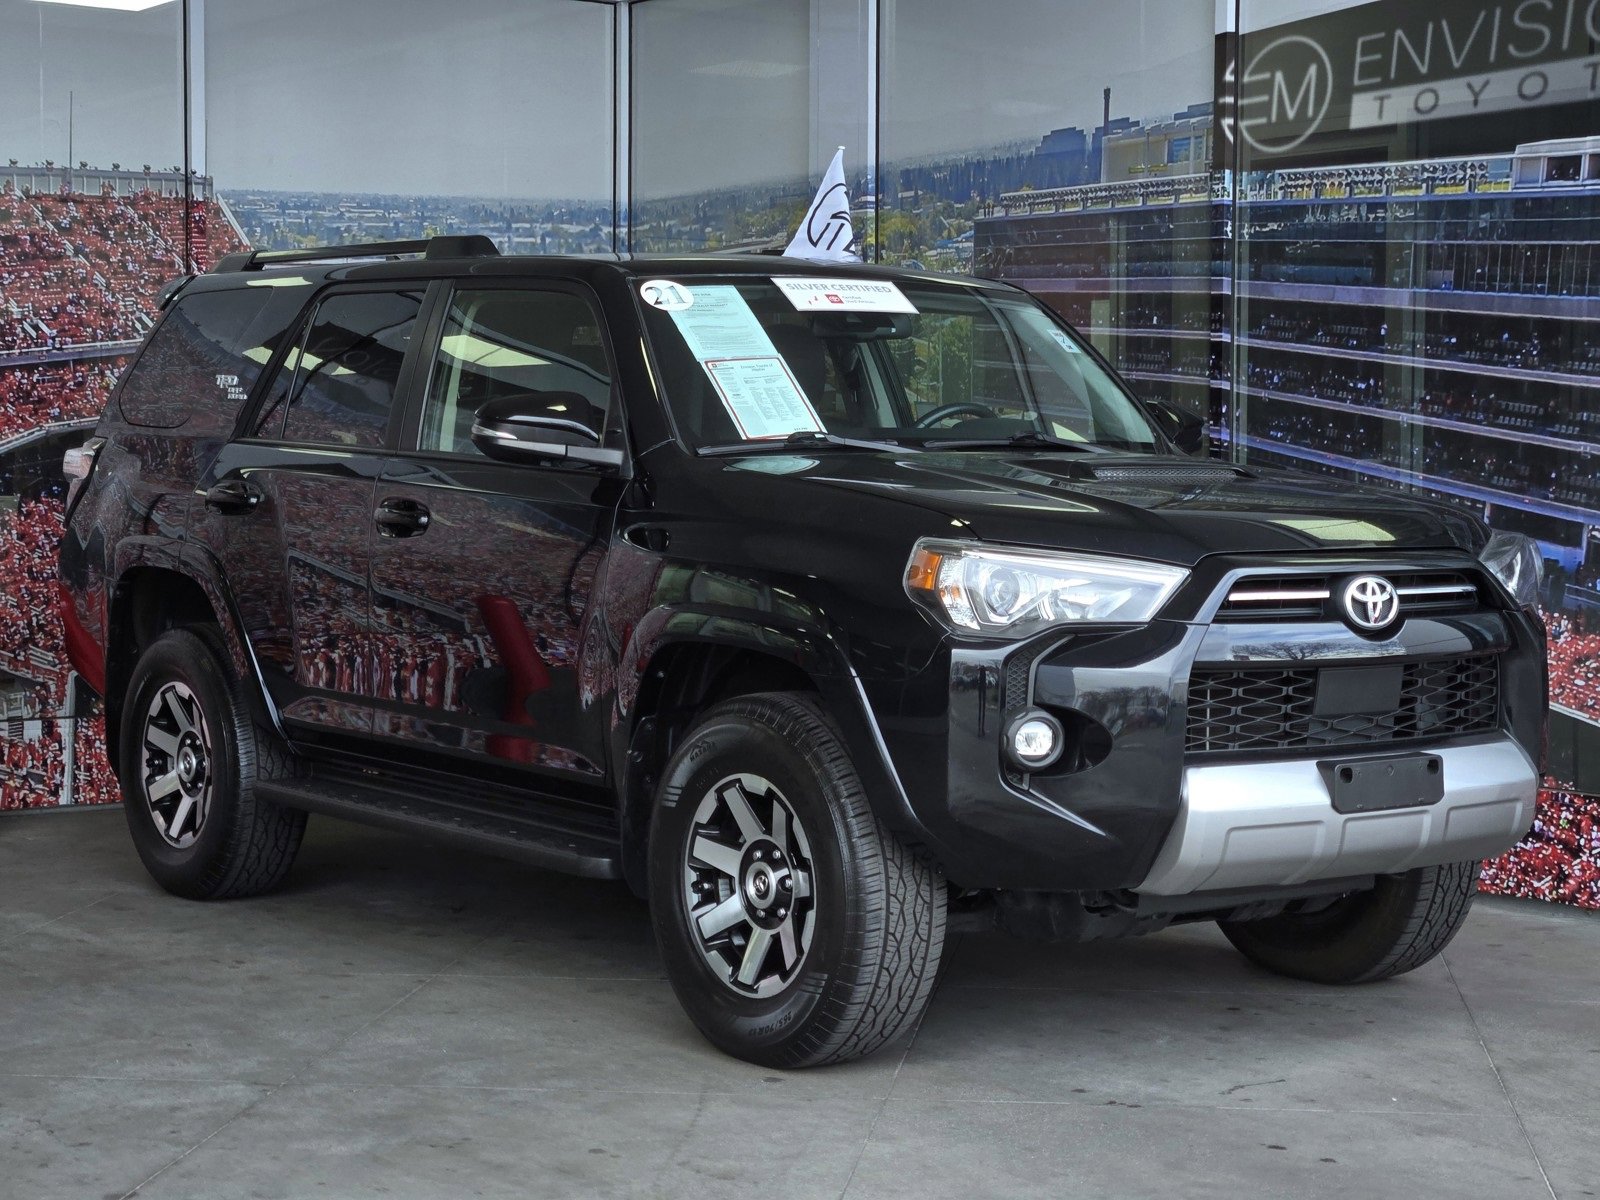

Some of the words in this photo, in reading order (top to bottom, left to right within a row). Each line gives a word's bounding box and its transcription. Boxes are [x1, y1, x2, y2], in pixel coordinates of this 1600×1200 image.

[645, 285, 687, 306] 21
[785, 283, 830, 292] SILVER
[830, 284, 892, 294] CERTIFIED
